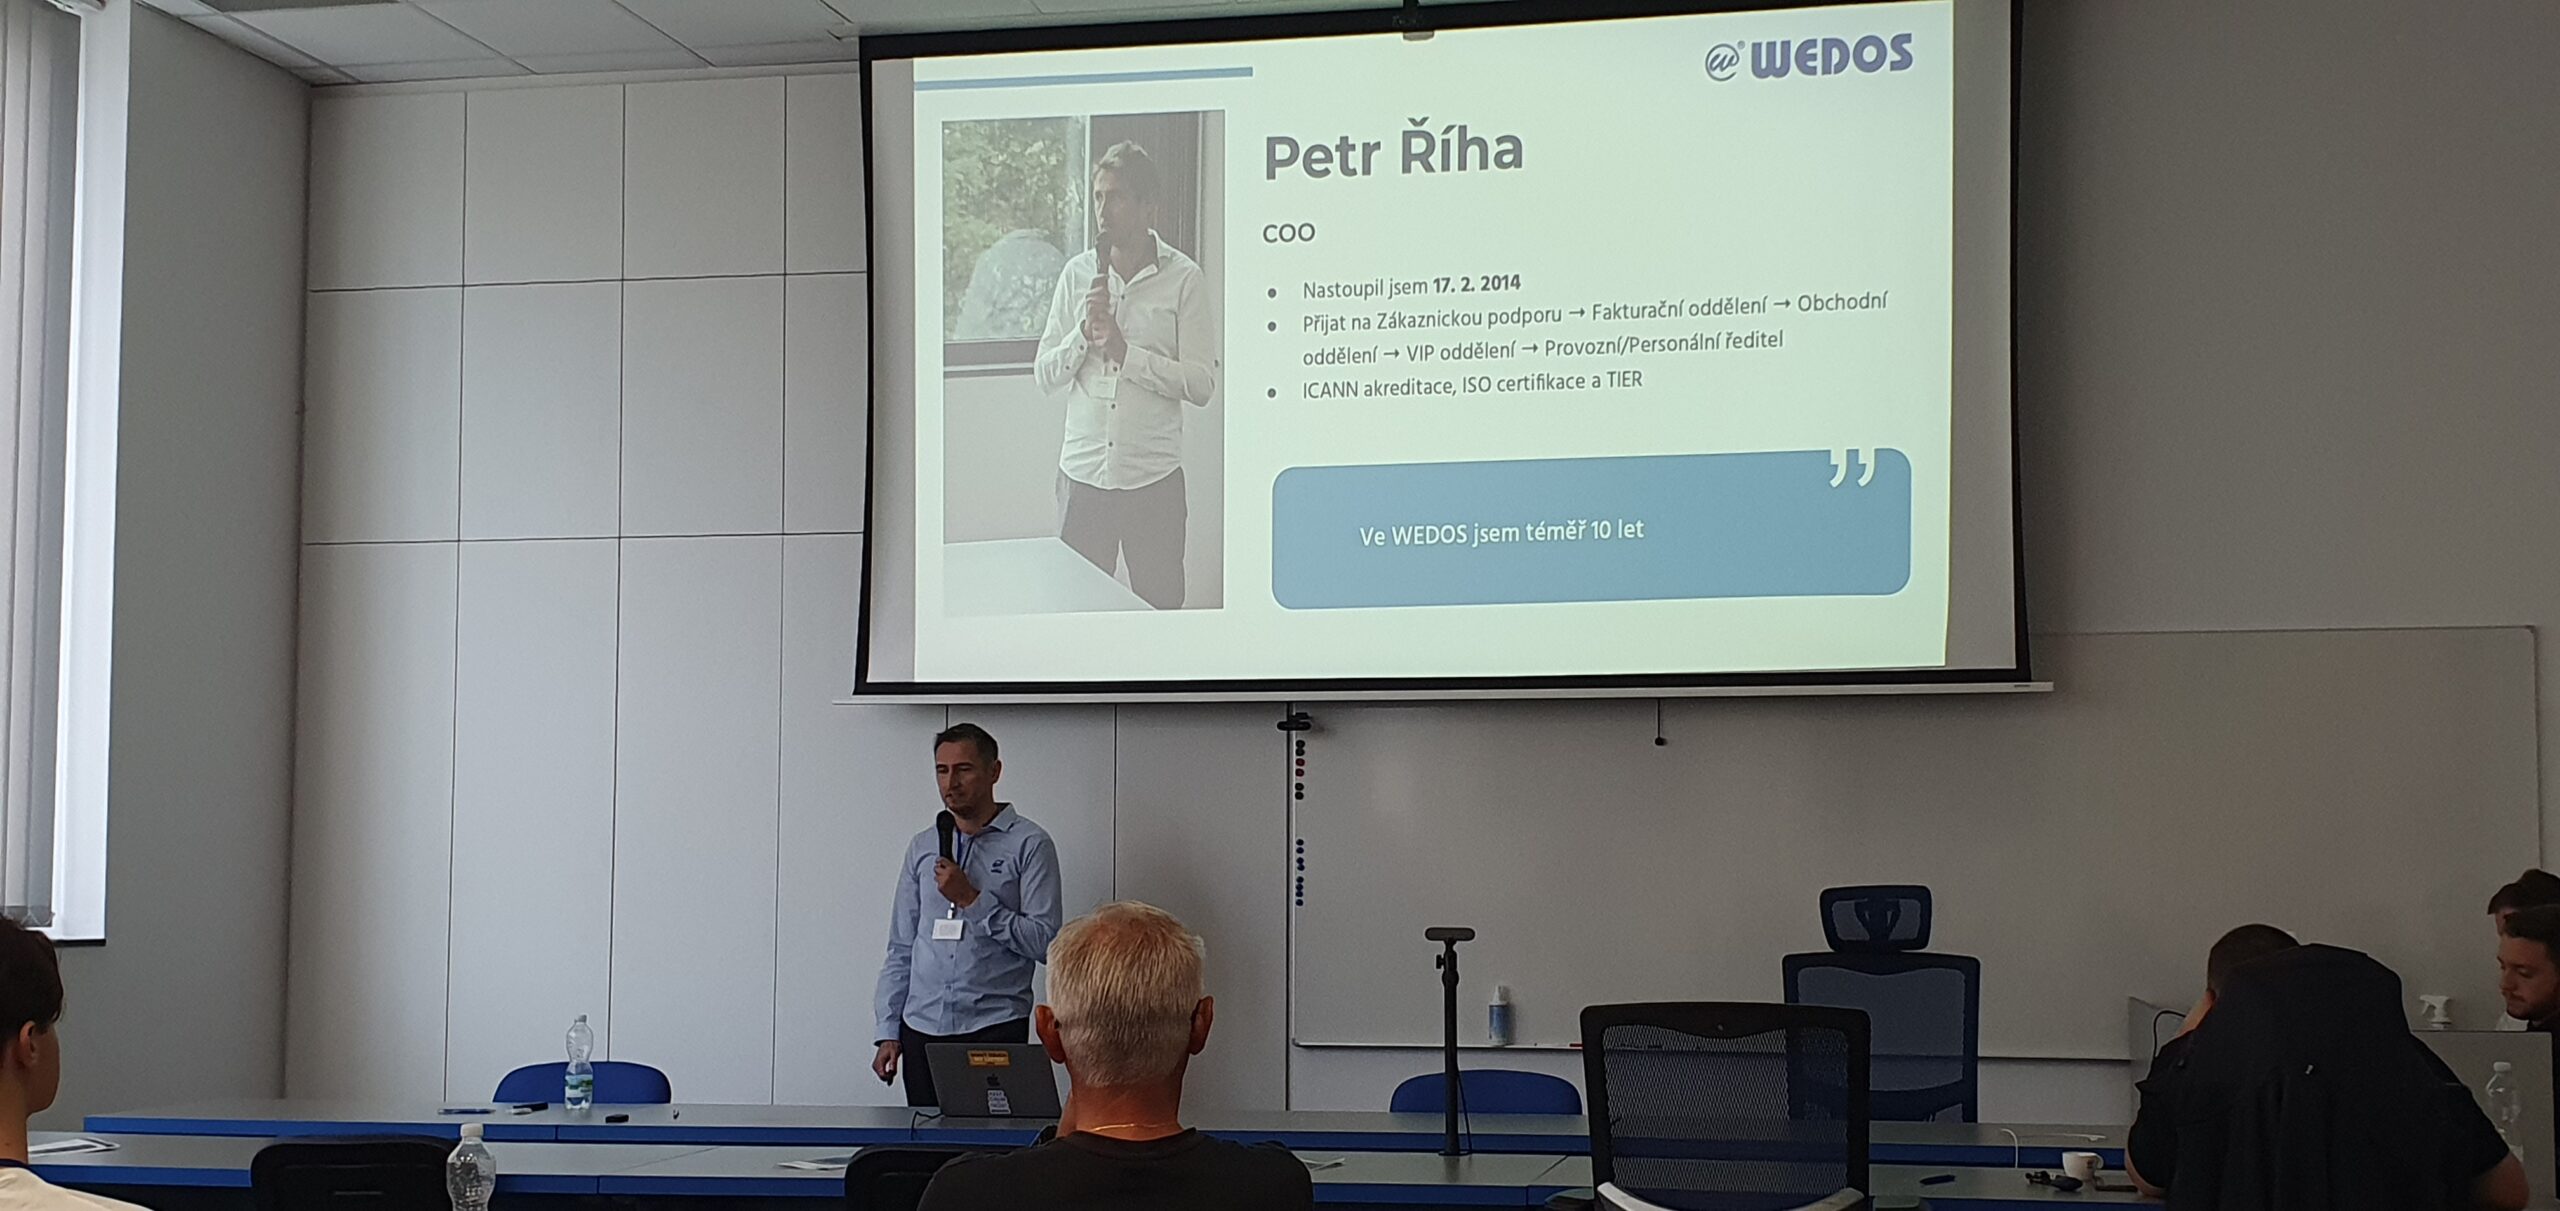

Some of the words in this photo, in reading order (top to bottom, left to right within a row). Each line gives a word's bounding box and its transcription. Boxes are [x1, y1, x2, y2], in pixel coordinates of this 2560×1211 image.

[1751, 33, 1913, 79] WEDOS
[1265, 135, 1381, 180] Petr
[1401, 117, 1523, 174] Říha
[1262, 222, 1316, 244] COO
[1303, 278, 1383, 301] Nastoupil
[1387, 278, 1428, 300] jsem
[1432, 277, 1456, 294] 17.
[1460, 276, 1475, 293] 2.
[1480, 274, 1521, 292] 2014
[1303, 314, 1346, 336] Přijat
[1351, 316, 1370, 331] na
[1377, 309, 1482, 330] Zákaznickou
[1488, 306, 1562, 329] podporu
[1592, 299, 1685, 321] Fakturační
[1688, 295, 1768, 317] oddělení
[1798, 290, 1888, 312] Obchodní
[1303, 345, 1378, 366] oddělení
[1407, 345, 1435, 362] VIP
[1440, 340, 1516, 361] oddělení
[1545, 332, 1721, 356] Provozní/Personální
[1725, 329, 1784, 350] ředitel
[1303, 381, 1358, 399] ICANN
[1363, 378, 1457, 397] akreditace,
[1462, 376, 1491, 393] ISO
[1497, 373, 1585, 393] certifikace
[1591, 375, 1601, 389] a
[1607, 371, 1643, 388] TIER
[1359, 526, 1386, 546] Ve
[1391, 525, 1467, 546] WEDOS
[1472, 523, 1520, 547] jsem
[1525, 519, 1588, 542] téměř
[1590, 521, 1611, 540] 10
[1618, 519, 1645, 539] let
